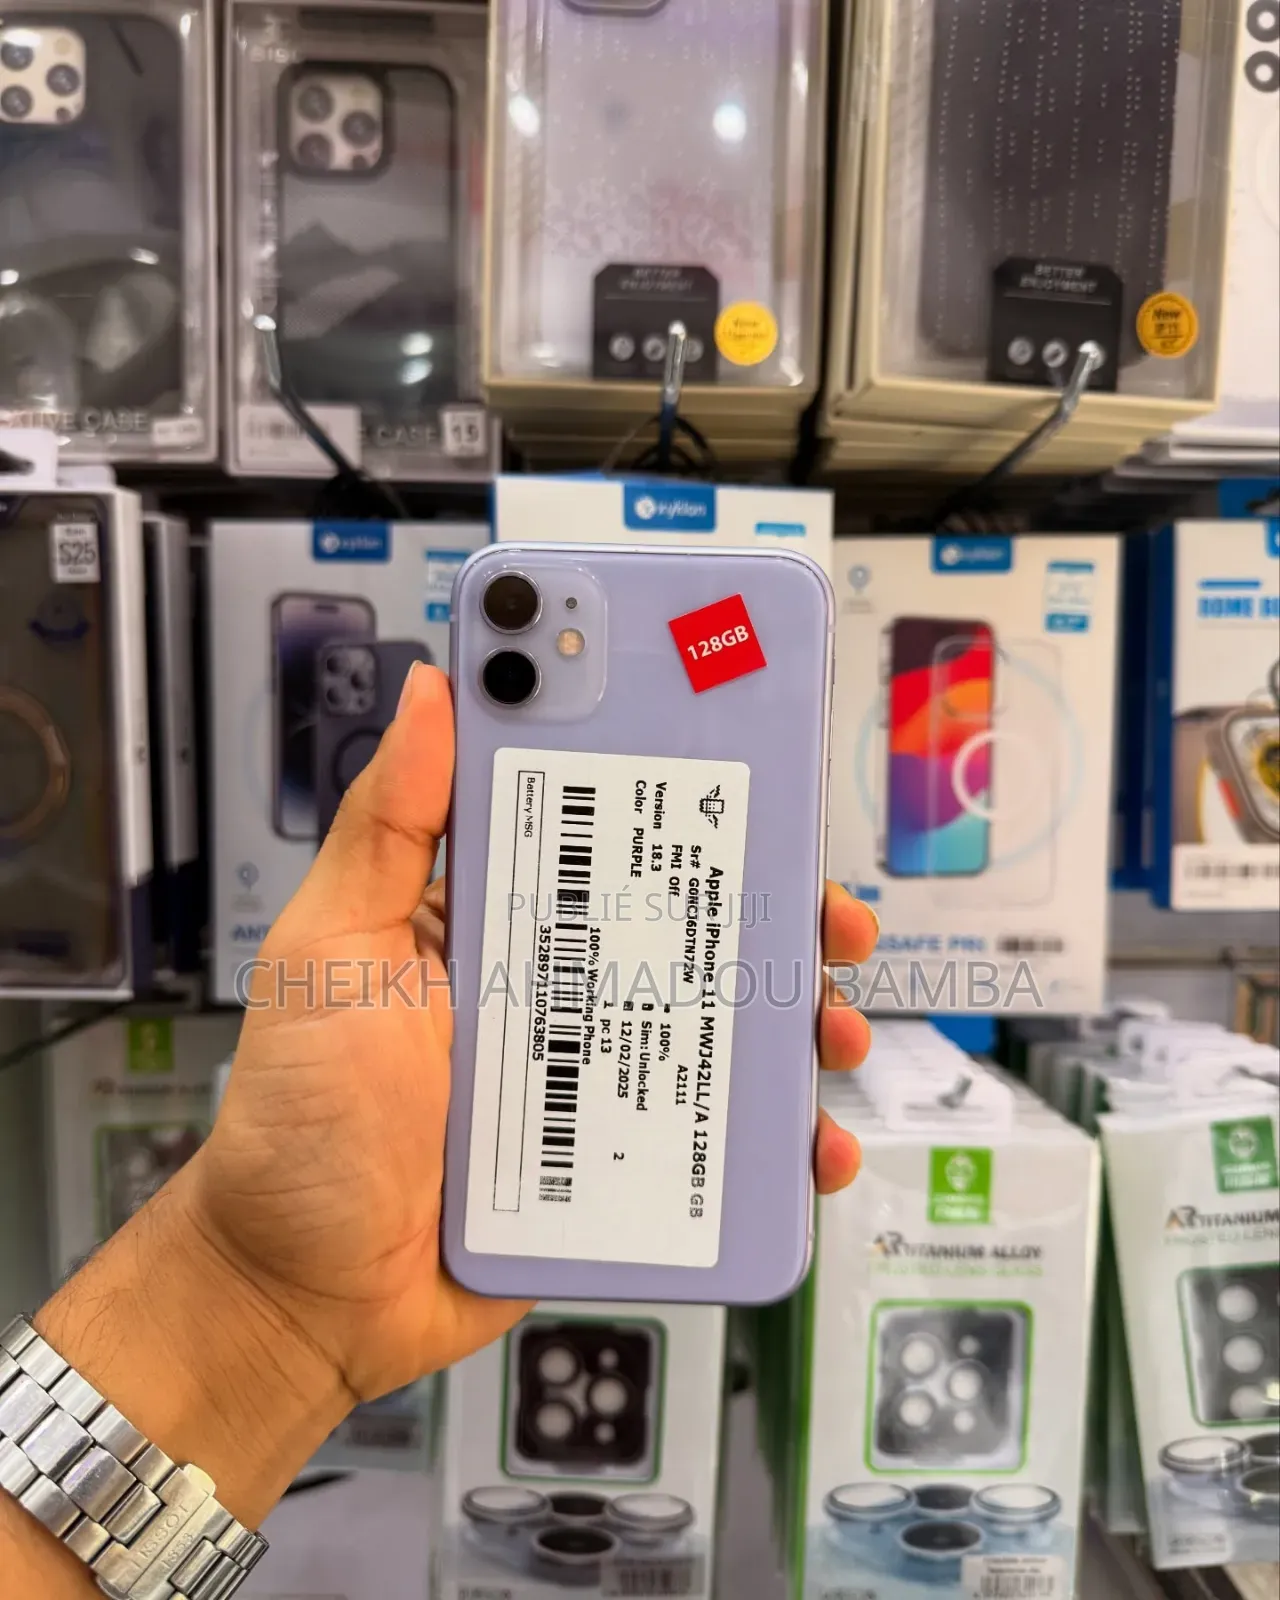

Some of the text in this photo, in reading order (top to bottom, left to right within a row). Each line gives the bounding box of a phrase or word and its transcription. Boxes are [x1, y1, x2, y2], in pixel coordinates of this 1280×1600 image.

[687, 624, 749, 661] 128GB
[523, 777, 535, 838] Battery MSG
[630, 780, 647, 878] Color PURPLE
[650, 781, 667, 872] Version 18.3
[668, 844, 683, 897] FMI Off
[689, 845, 702, 869] Sr#
[532, 925, 551, 1061] 352897110763805
[582, 926, 600, 1065] 100% Working Phone
[600, 1019, 612, 1054] pc 13
[617, 1020, 633, 1099] 12/02/2025
[636, 1020, 653, 1111] Sim: Unlocked
[658, 1023, 671, 1062] 100%
[689, 866, 724, 1218] Apple iPhone 11 MWJ42LL/A 128GB GB
[675, 1064, 689, 1105] A2111
[613, 1152, 625, 1161] 2
